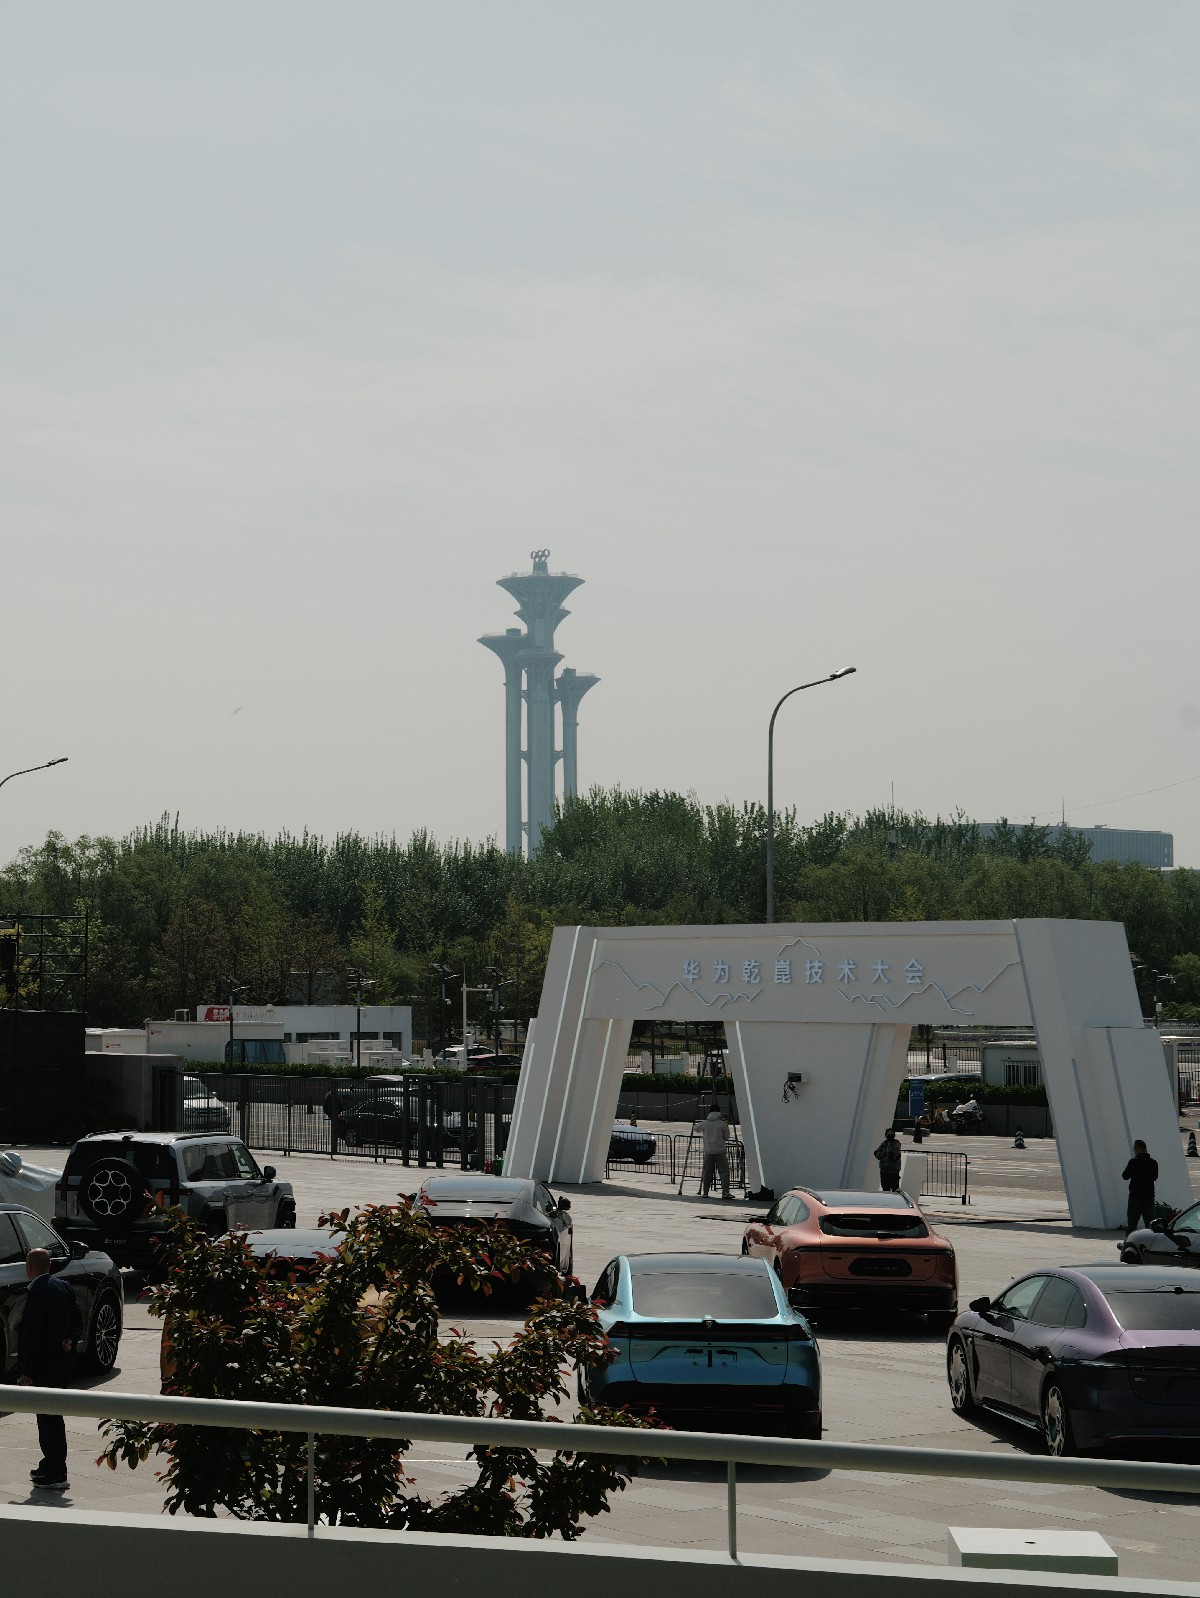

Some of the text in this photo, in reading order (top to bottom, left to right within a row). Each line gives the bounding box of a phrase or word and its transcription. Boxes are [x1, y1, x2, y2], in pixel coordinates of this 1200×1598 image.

[682, 958, 925, 985] 华为乾崑技术大会
